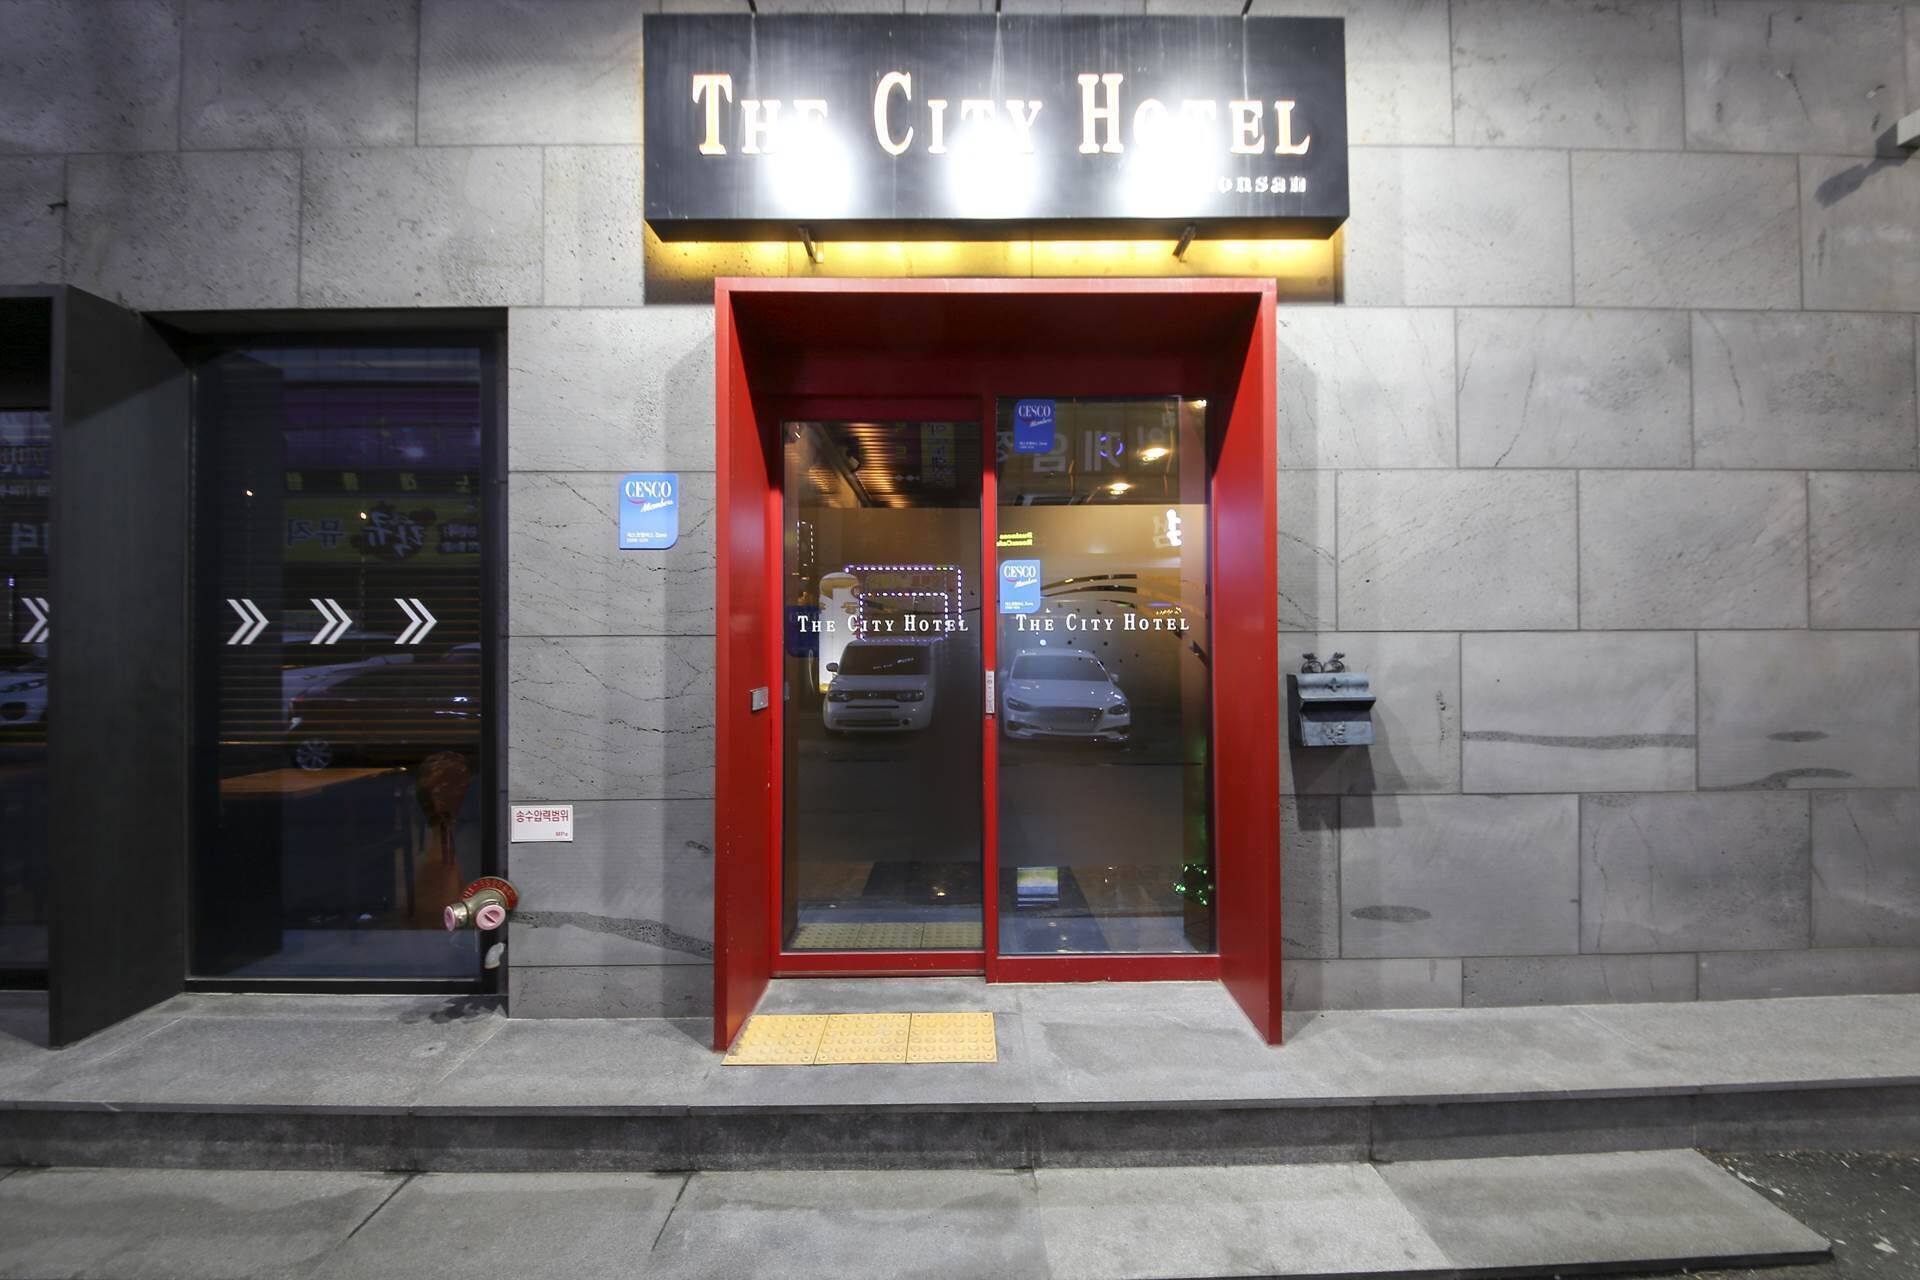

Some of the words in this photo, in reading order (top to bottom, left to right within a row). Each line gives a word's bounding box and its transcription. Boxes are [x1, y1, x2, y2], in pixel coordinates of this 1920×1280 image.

[692, 74, 828, 155] THE
[874, 71, 1043, 156] CITY
[1077, 73, 1311, 155] HOTEL
[1208, 175, 1307, 194] onsan
[1018, 405, 1051, 417] CESCO
[625, 480, 672, 498] CESCO
[1003, 565, 1037, 578] CESCO
[797, 614, 836, 632] THE
[847, 614, 895, 632] CITY
[904, 614, 969, 632] HOTEL
[1016, 613, 1055, 631] THE
[1065, 613, 1115, 631] CITY
[1123, 613, 1190, 631] HOTEL
[516, 809, 569, 823] 송수압력범위
